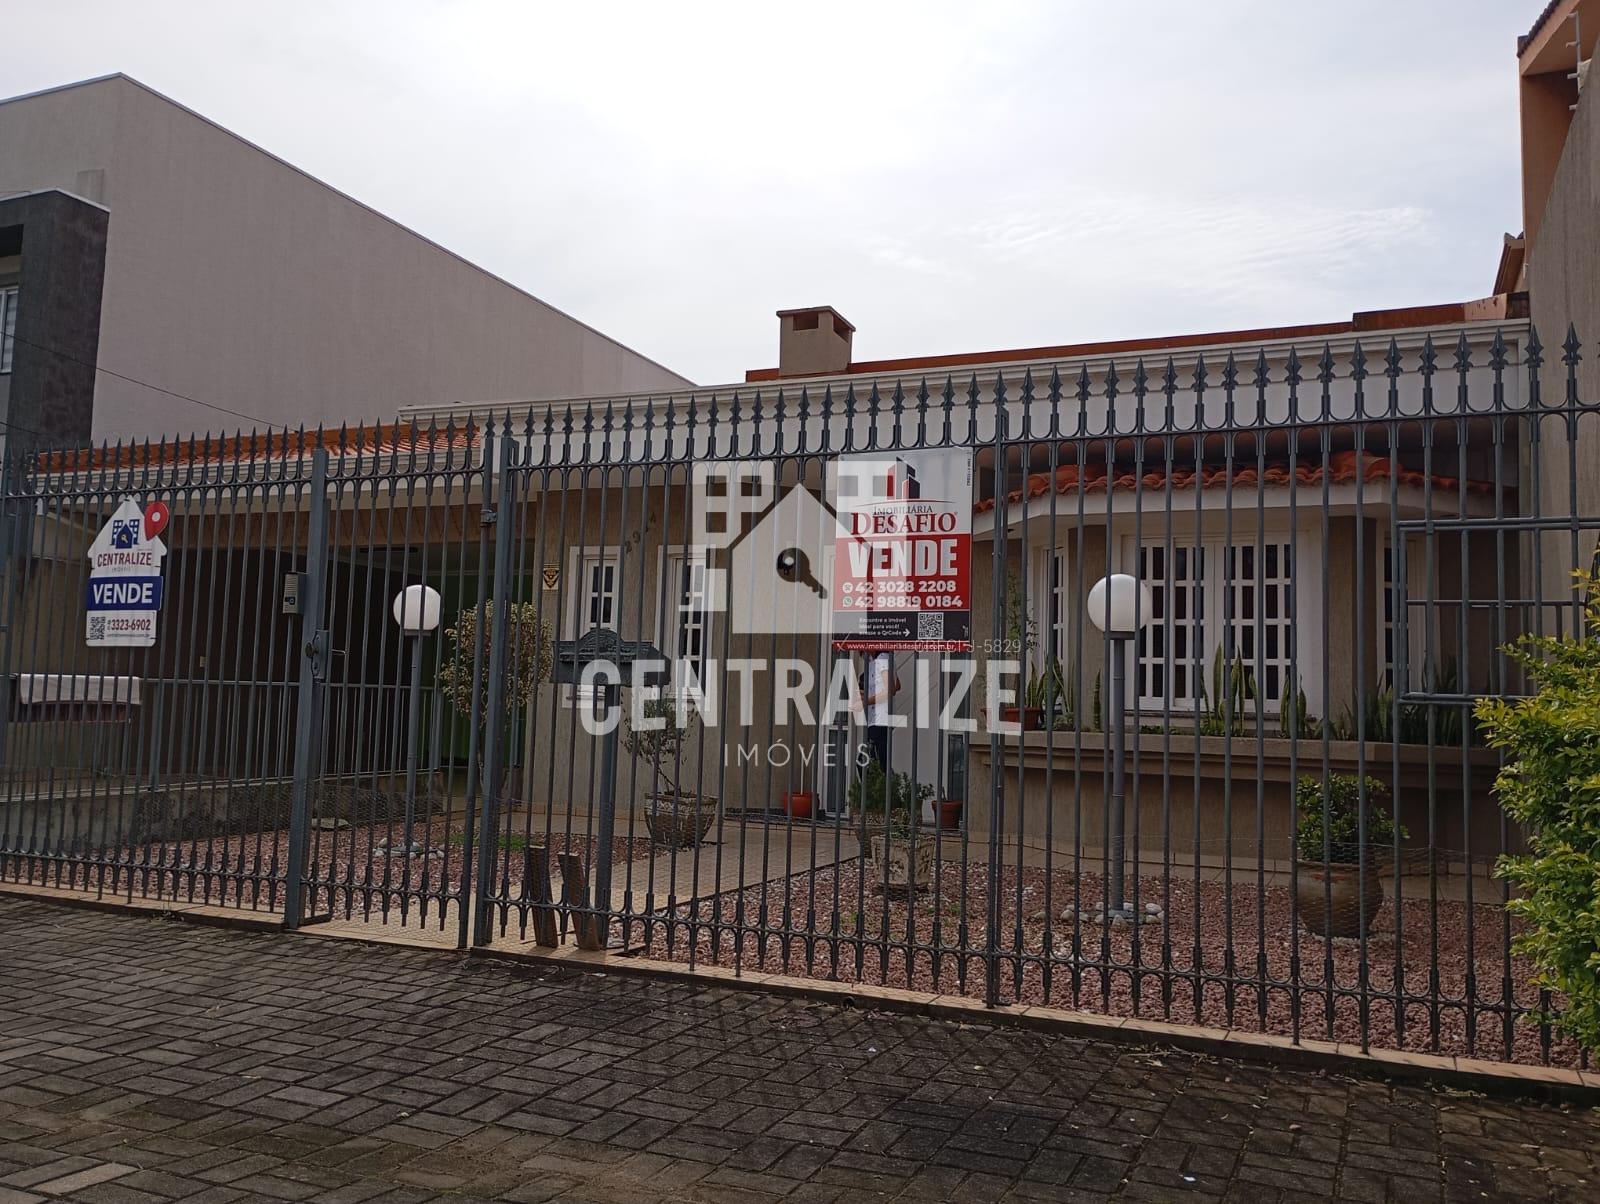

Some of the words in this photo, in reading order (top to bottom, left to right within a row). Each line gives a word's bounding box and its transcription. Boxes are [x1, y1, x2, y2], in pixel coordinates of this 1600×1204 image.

[873, 504, 933, 516] IMOBILIÁRIA
[850, 512, 957, 535] DESAFIO
[97, 552, 152, 567] CENTRALIZE
[848, 538, 958, 578] VENDE
[855, 581, 874, 593] 42
[877, 580, 915, 593] 3028
[918, 580, 957, 592] 2208
[93, 583, 153, 605] VENDE
[855, 596, 874, 608] 42
[877, 596, 921, 608] 98819
[925, 595, 963, 608] 0184
[111, 619, 151, 631] 3323-6902
